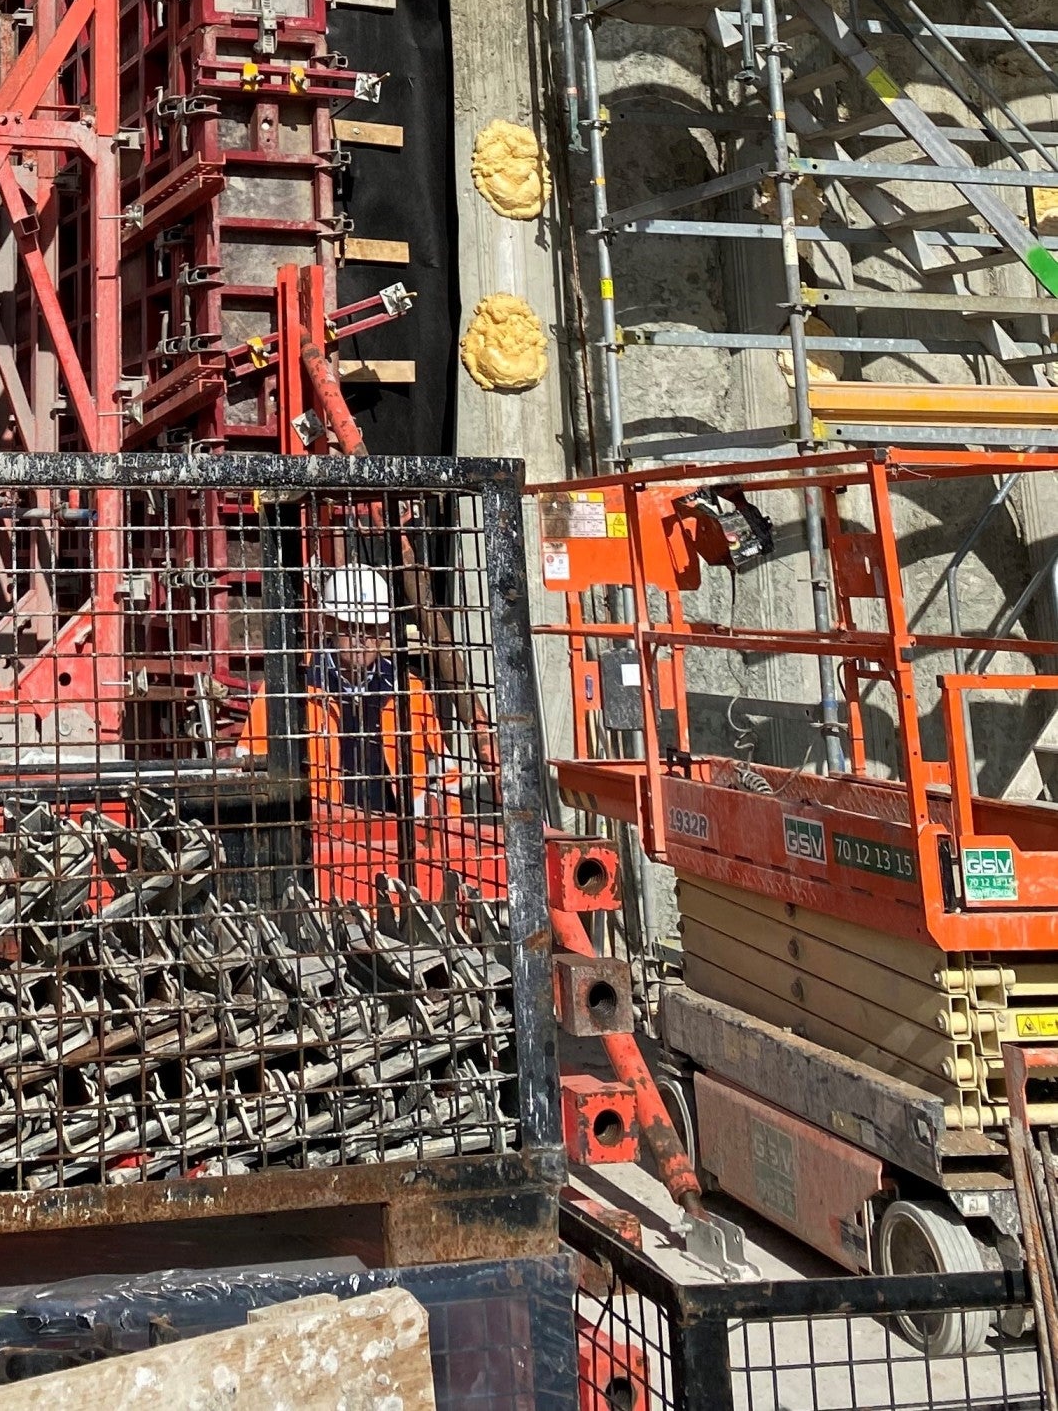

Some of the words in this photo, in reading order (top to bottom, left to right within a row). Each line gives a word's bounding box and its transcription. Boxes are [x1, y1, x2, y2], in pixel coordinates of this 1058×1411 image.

[669, 807, 709, 841] 1932R
[786, 830, 823, 859] GSV
[834, 838, 851, 861] 70
[856, 843, 871, 866] 12
[876, 847, 892, 871] 13
[897, 852, 913, 876] 15
[967, 859, 1011, 874] GSV
